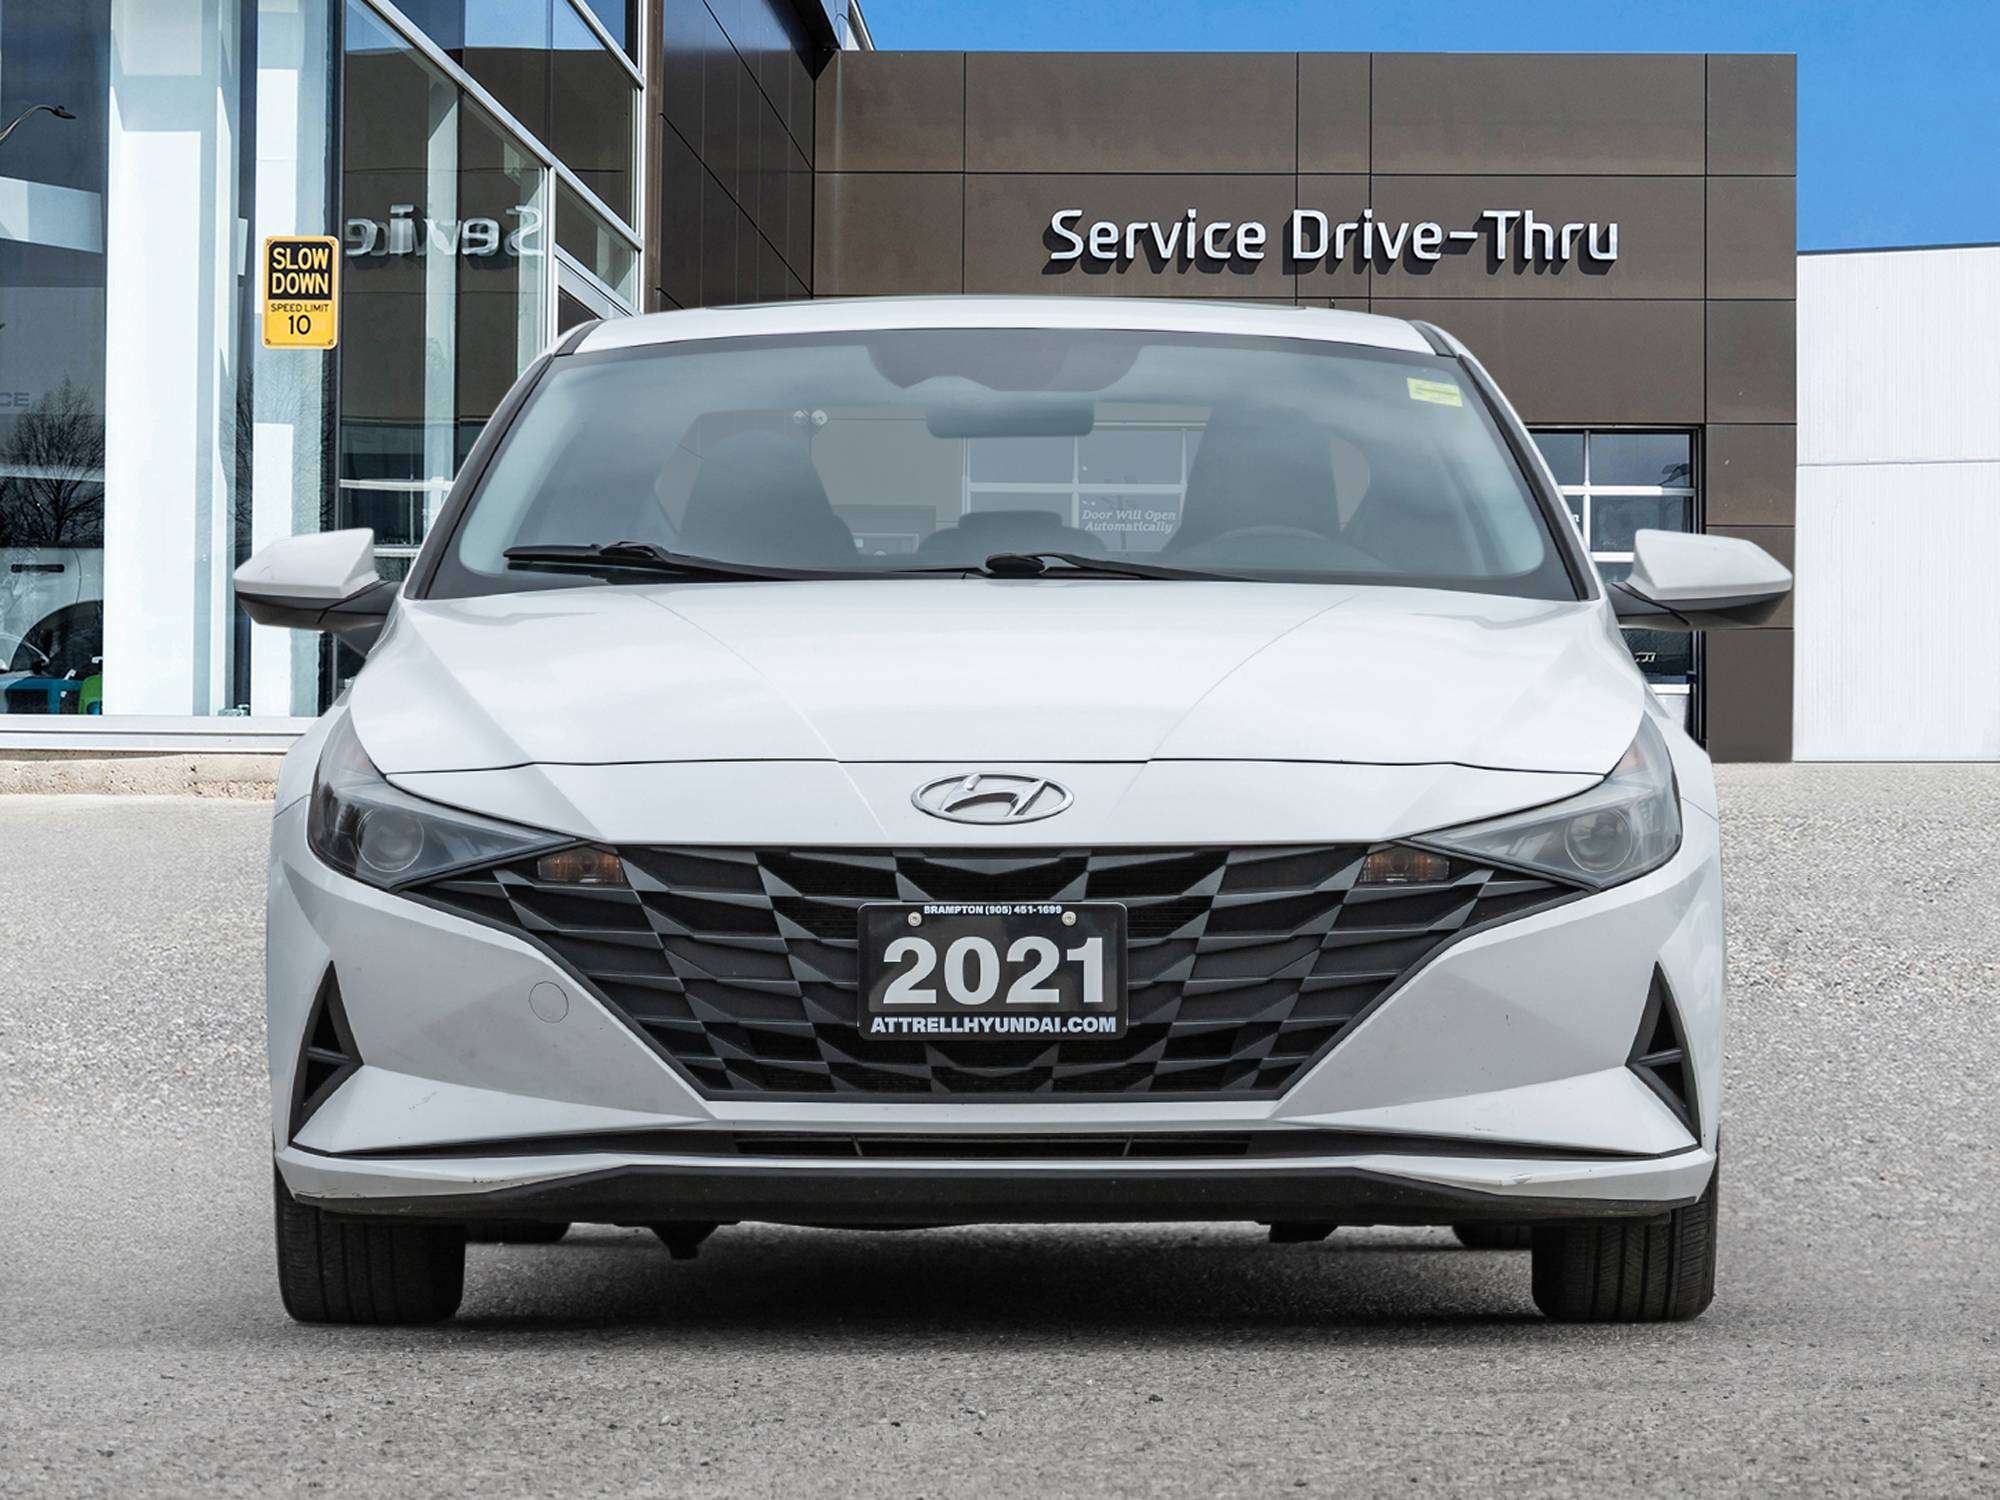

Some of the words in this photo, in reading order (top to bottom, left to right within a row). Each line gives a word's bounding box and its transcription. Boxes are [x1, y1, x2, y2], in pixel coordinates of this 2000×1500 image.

[1051, 208, 1266, 259] Service
[1293, 208, 1618, 260] Drive-Thru
[272, 247, 329, 270] SLOW
[271, 272, 329, 294] DOWN
[271, 303, 303, 313] SPEED
[304, 303, 329, 313] LIMIT
[288, 314, 311, 335] 10
[1081, 510, 1113, 521] Door
[1116, 510, 1143, 521] Will
[1144, 510, 1177, 523] Open
[1084, 521, 1173, 534] Automatically
[924, 905, 983, 915] BRAMPTON
[985, 905, 1012, 916] (905)
[883, 936, 1103, 1006] 2021
[870, 1016, 1117, 1033] ATTRELLHYUNDAI.COM
